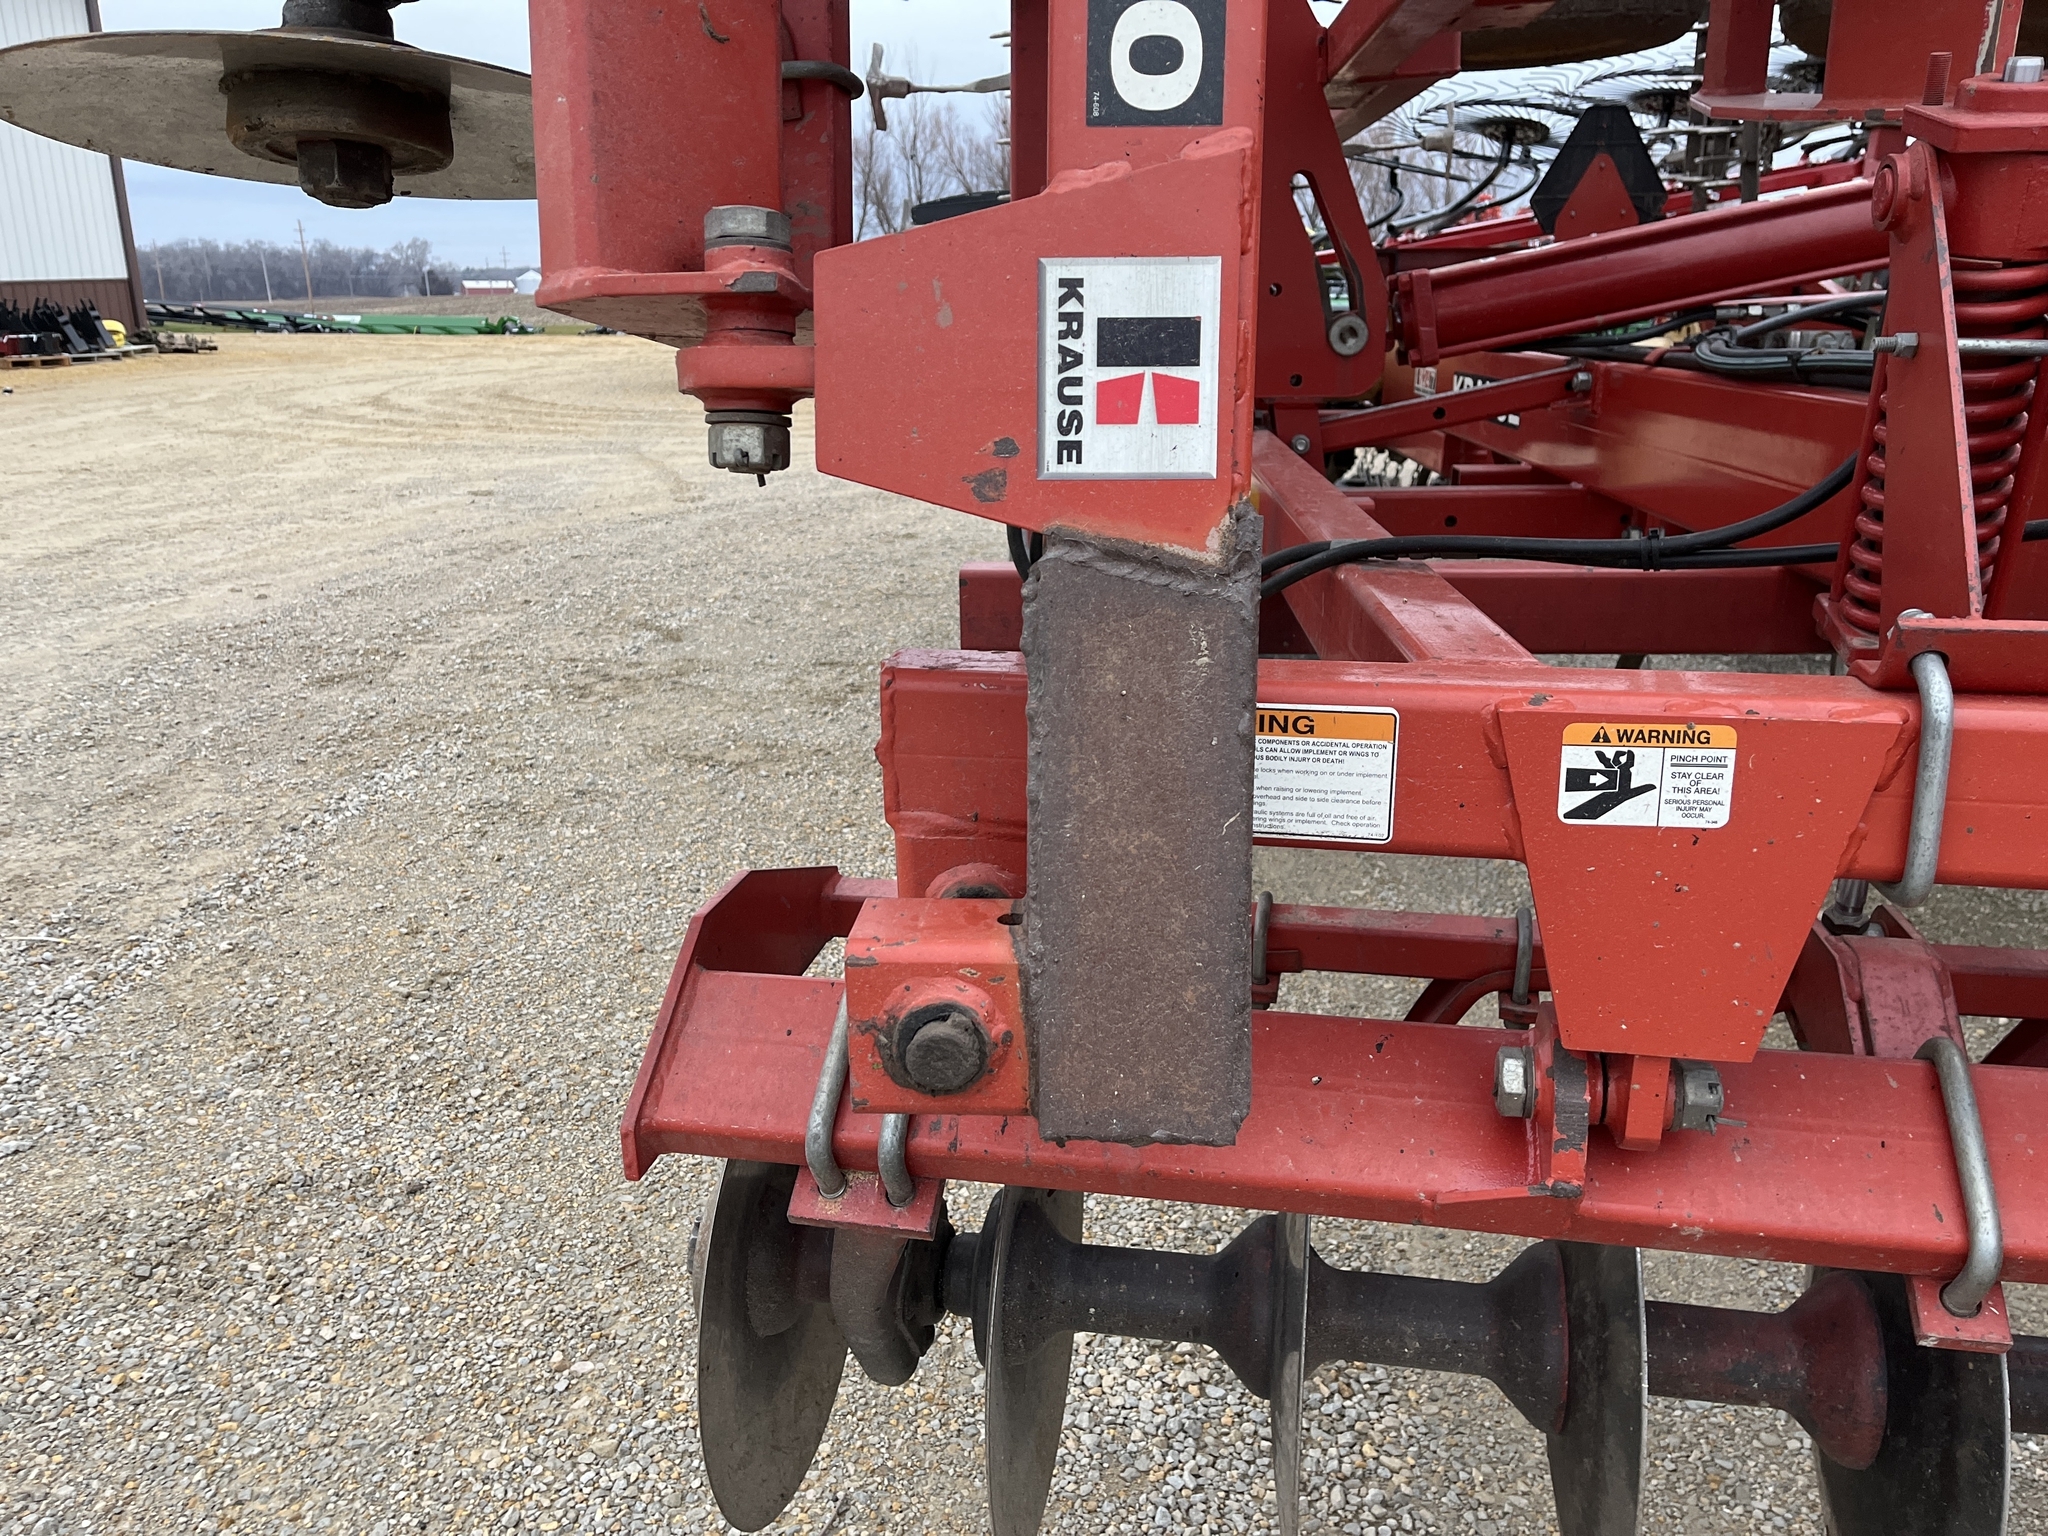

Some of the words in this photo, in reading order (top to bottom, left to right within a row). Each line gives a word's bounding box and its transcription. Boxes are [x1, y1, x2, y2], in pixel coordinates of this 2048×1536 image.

[1057, 277, 1084, 465] KRAUSE
[1259, 714, 1314, 734] ING
[1616, 728, 1711, 744] WARNING
[1258, 738, 1300, 746] COMPONENTS
[1351, 742, 1387, 750] OPERATION
[1670, 754, 1698, 762] PINCH
[1700, 755, 1728, 763] POINT
[1295, 769, 1318, 777] working
[1670, 771, 1693, 779] STAY
[1694, 772, 1724, 780] CLEAR
[1689, 779, 1702, 787] OF
[1672, 786, 1692, 794] THIS
[1694, 787, 1720, 795] AREA!
